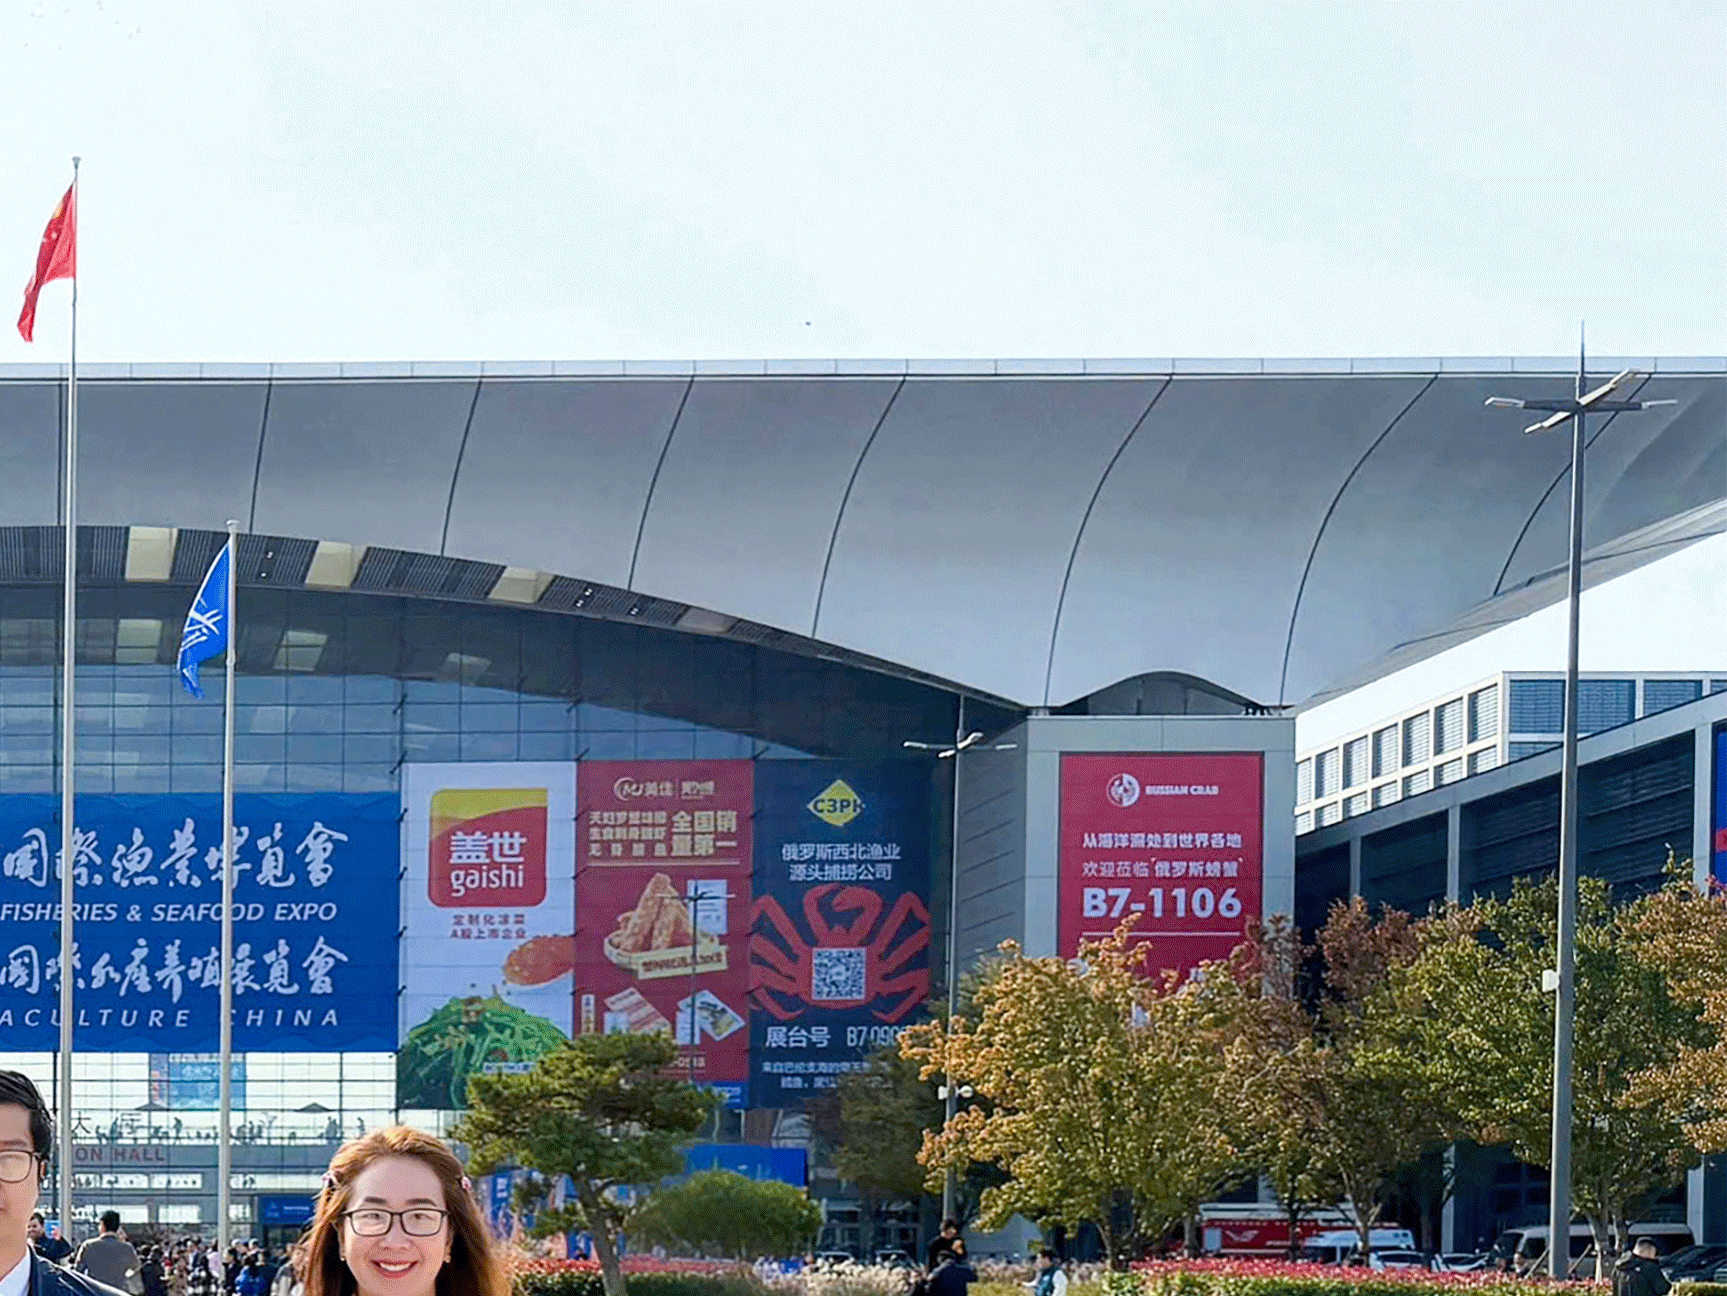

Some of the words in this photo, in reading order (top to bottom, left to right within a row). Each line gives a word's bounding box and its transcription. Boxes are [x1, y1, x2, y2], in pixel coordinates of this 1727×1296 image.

[449, 830, 528, 865] 盖世
[781, 843, 901, 862] 俄罗斯西北渔业
[450, 865, 525, 897] gaishi
[788, 863, 893, 881] 源头捕捞公司
[0, 903, 119, 922] FISHERIES
[125, 903, 143, 922] &
[273, 903, 338, 922] EXPO
[1082, 886, 1242, 918] B7-1106
[765, 1025, 831, 1048] 展台号
[74, 1147, 103, 1162] ON
[113, 1147, 165, 1162] HALL
